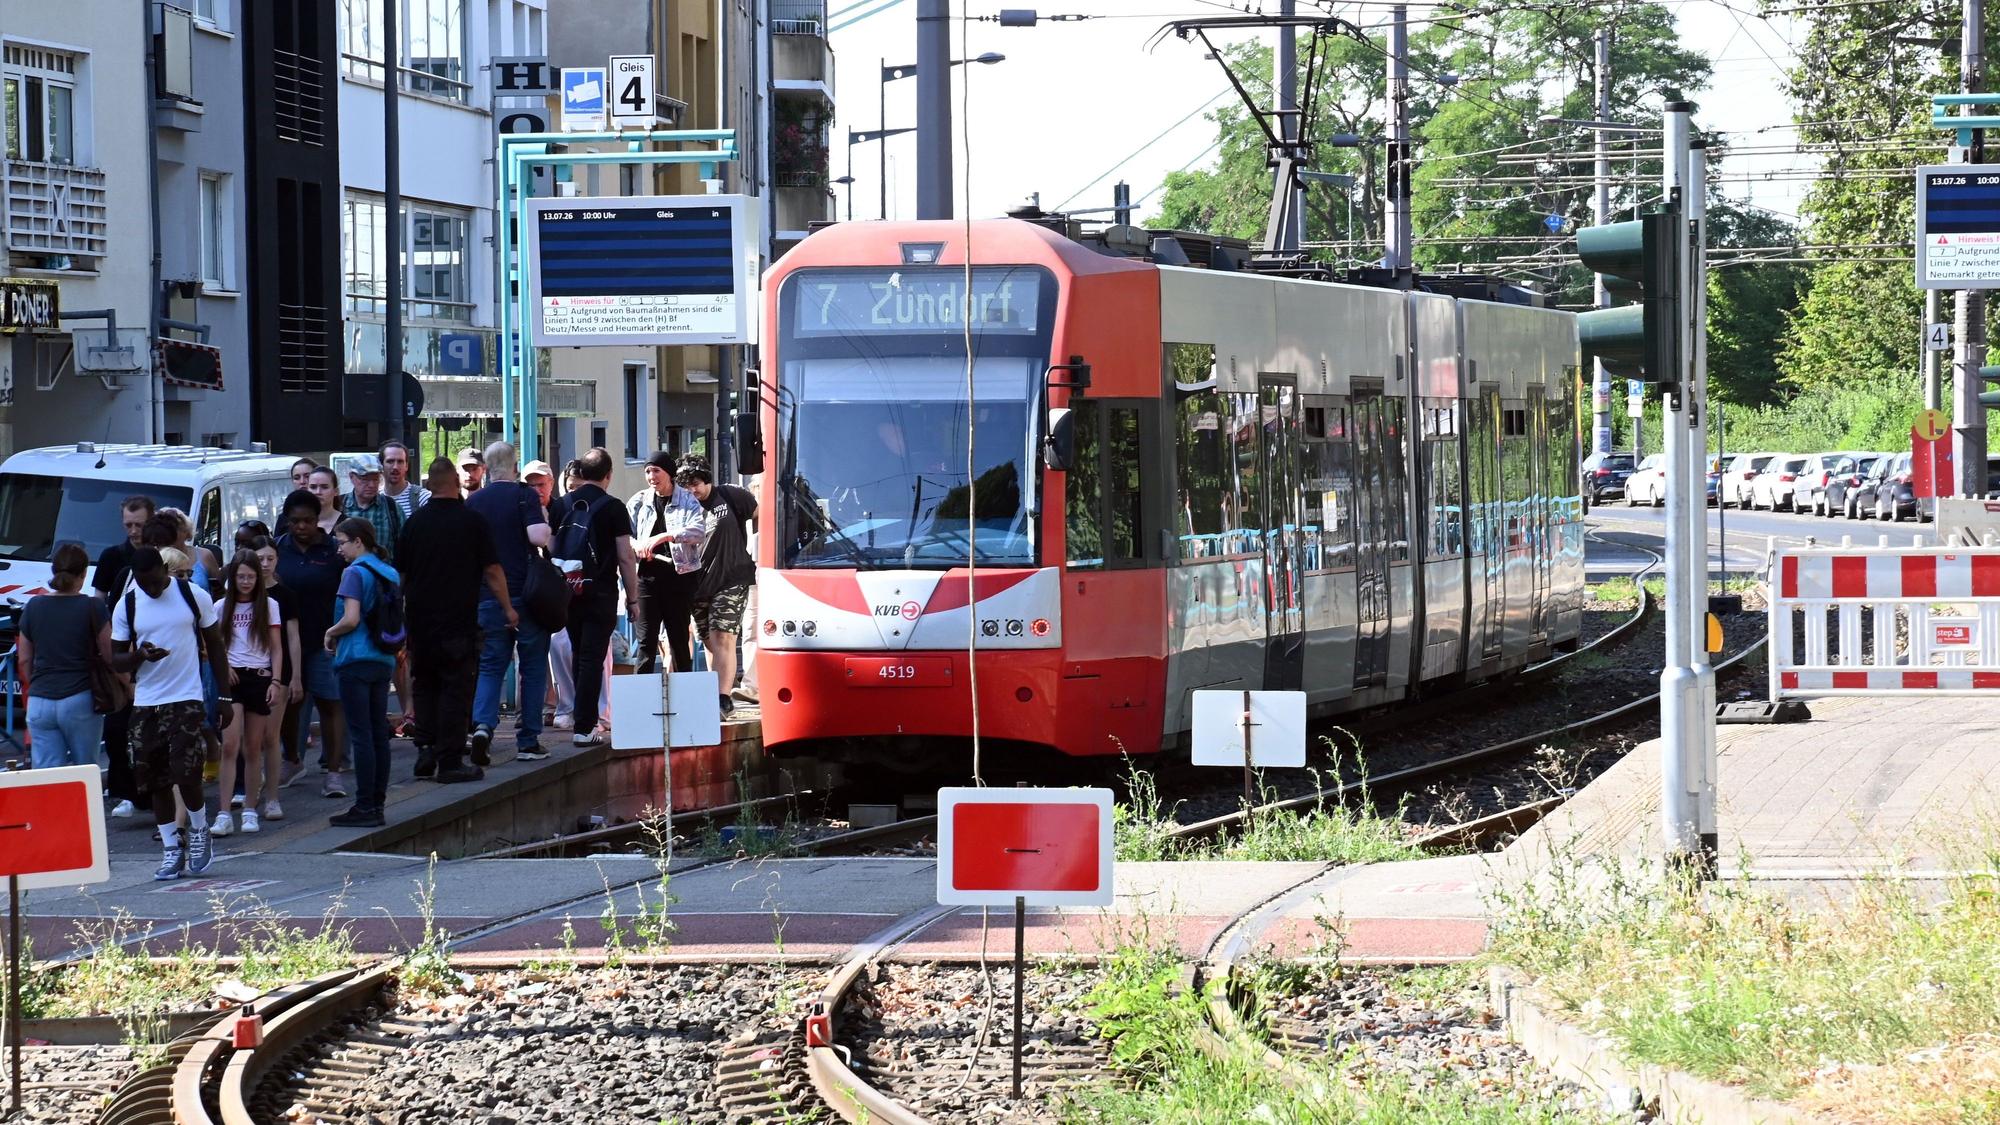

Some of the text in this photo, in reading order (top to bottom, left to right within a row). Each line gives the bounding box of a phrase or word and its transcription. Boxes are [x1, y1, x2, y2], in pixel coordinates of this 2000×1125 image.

[619, 62, 645, 72] Gleis
[620, 76, 646, 111] 4
[1931, 177, 1999, 185] 13.07.26 10:00
[543, 212, 573, 220] 13.07.26
[582, 212, 602, 220] 10:00
[1958, 235, 1994, 243] Hinweis
[1940, 248, 1945, 256] 7
[1958, 247, 2000, 256] Aufgrund
[1930, 259, 1951, 267] Linie
[1930, 270, 1975, 278] Neumarkt
[570, 297, 615, 305] Hinweis für
[663, 297, 669, 305] 9
[715, 295, 729, 303] 4/5
[870, 282, 1013, 325] Zündorf
[817, 284, 838, 325] 7
[571, 308, 607, 316] Aufgrund
[625, 306, 690, 315] Baumaßnahmen
[692, 305, 708, 313] sind
[545, 316, 568, 324] Linien
[577, 316, 592, 324] und
[601, 315, 636, 323] zwischen
[655, 315, 667, 323] (H)
[545, 325, 597, 333] Deutz/Messe
[615, 324, 654, 332] Heumarkt
[656, 324, 693, 333] getrennt.
[1931, 327, 1944, 346] 4
[874, 604, 901, 616] KVB
[878, 665, 915, 678] 4519
